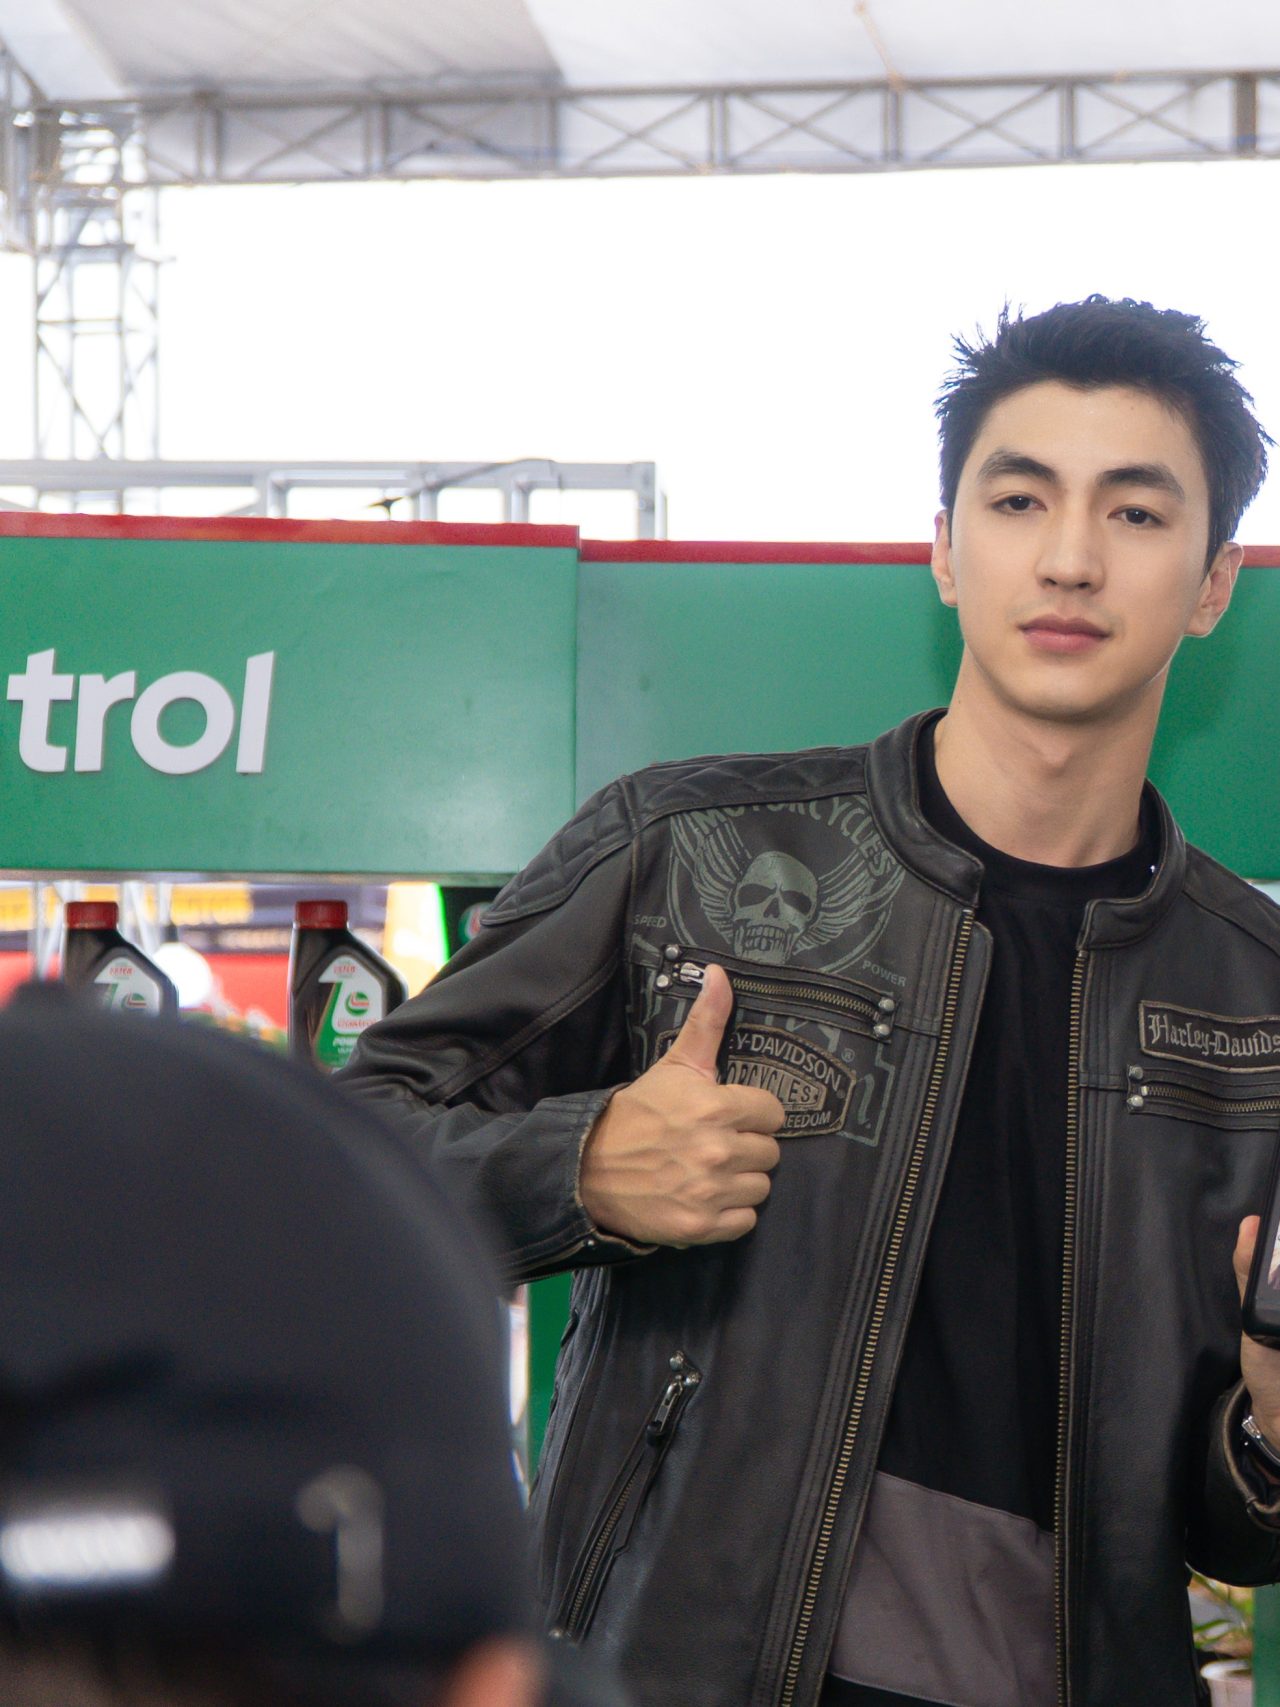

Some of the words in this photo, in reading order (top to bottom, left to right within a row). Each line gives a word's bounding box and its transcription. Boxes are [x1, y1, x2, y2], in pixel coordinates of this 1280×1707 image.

[7, 648, 274, 774] trol
[634, 914, 667, 928] SPEED
[862, 960, 906, 986] POWER
